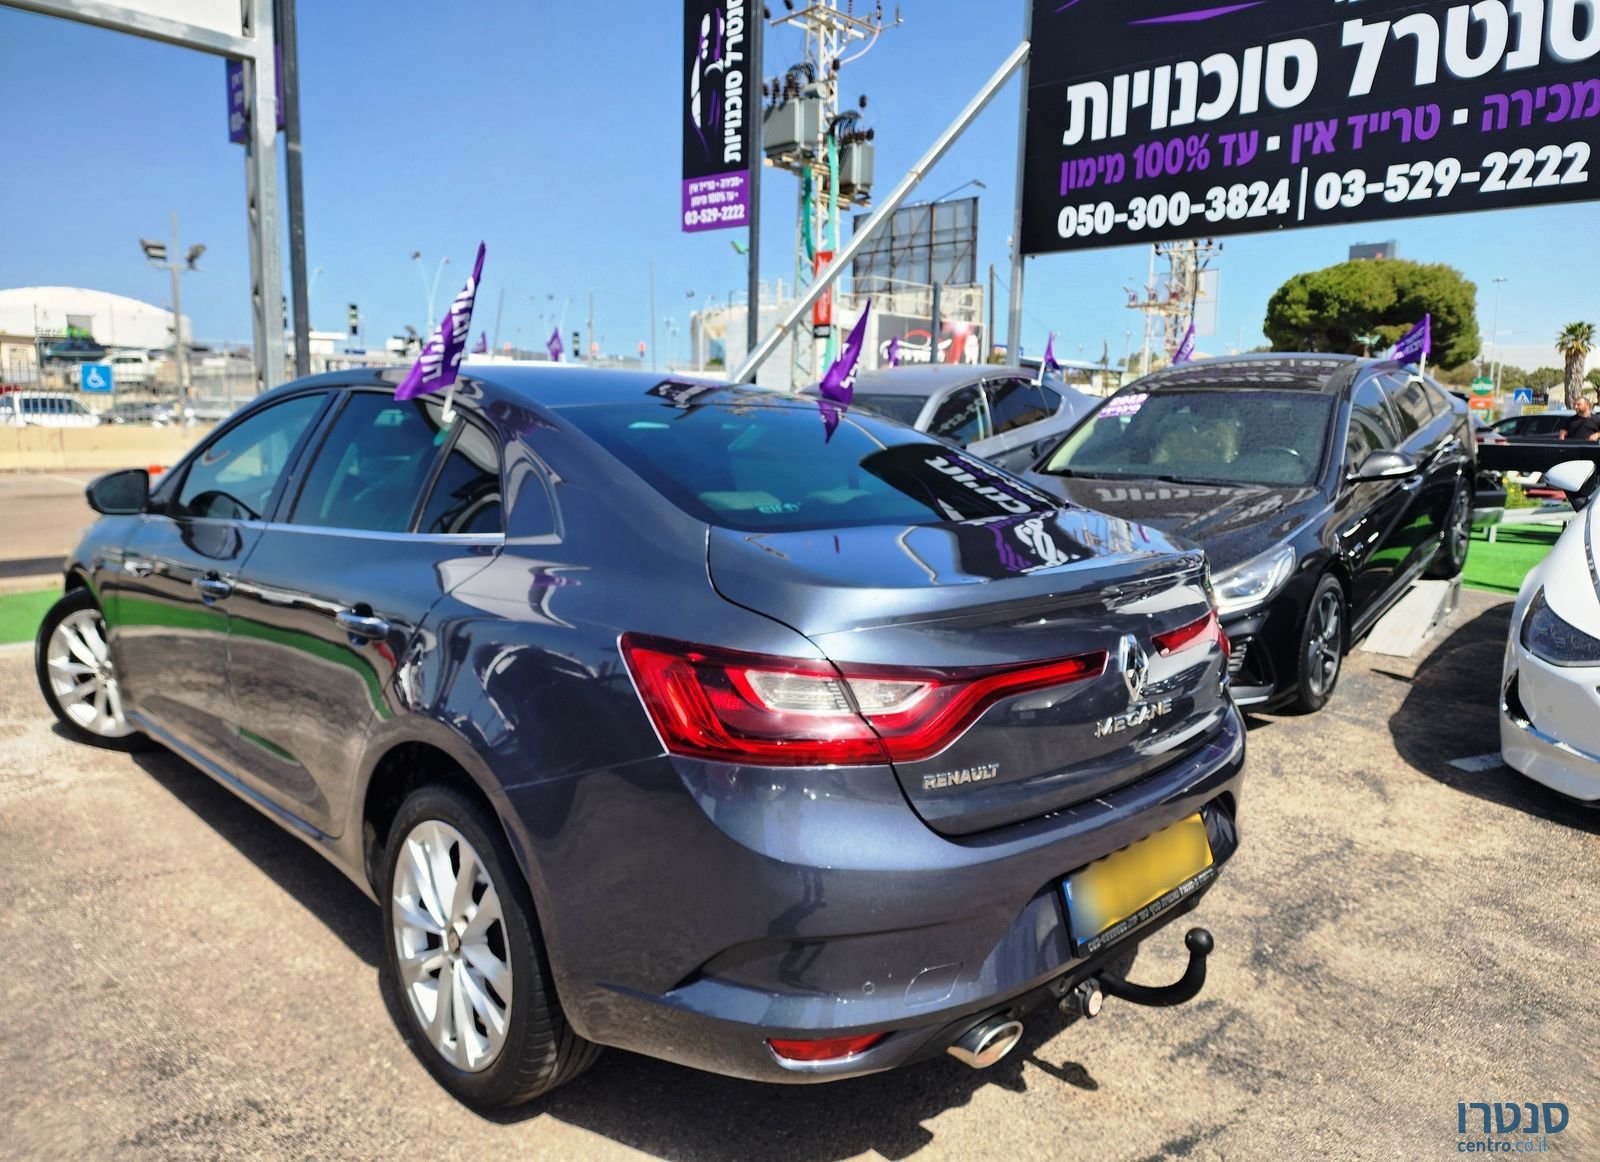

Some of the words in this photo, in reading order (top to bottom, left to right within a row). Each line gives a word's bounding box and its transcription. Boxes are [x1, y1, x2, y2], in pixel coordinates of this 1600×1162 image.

[1341, 0, 1600, 99] סנטרל
[1062, 37, 1318, 147] סוכנויות
[1481, 77, 1600, 133] מכירה
[723, 70, 744, 164] סוכנויות
[1348, 102, 1441, 149] טרייד
[1132, 133, 1211, 180] 100%
[1218, 130, 1259, 168] עד
[1289, 118, 1339, 164] אין
[1057, 178, 1291, 240] 050-300-3824
[1314, 141, 1590, 211] 03-529-2222
[1059, 152, 1126, 196] מימון
[684, 204, 745, 226] 03-529-2222
[1094, 697, 1174, 739] MEGANE
[921, 762, 1000, 791] RENAULT
